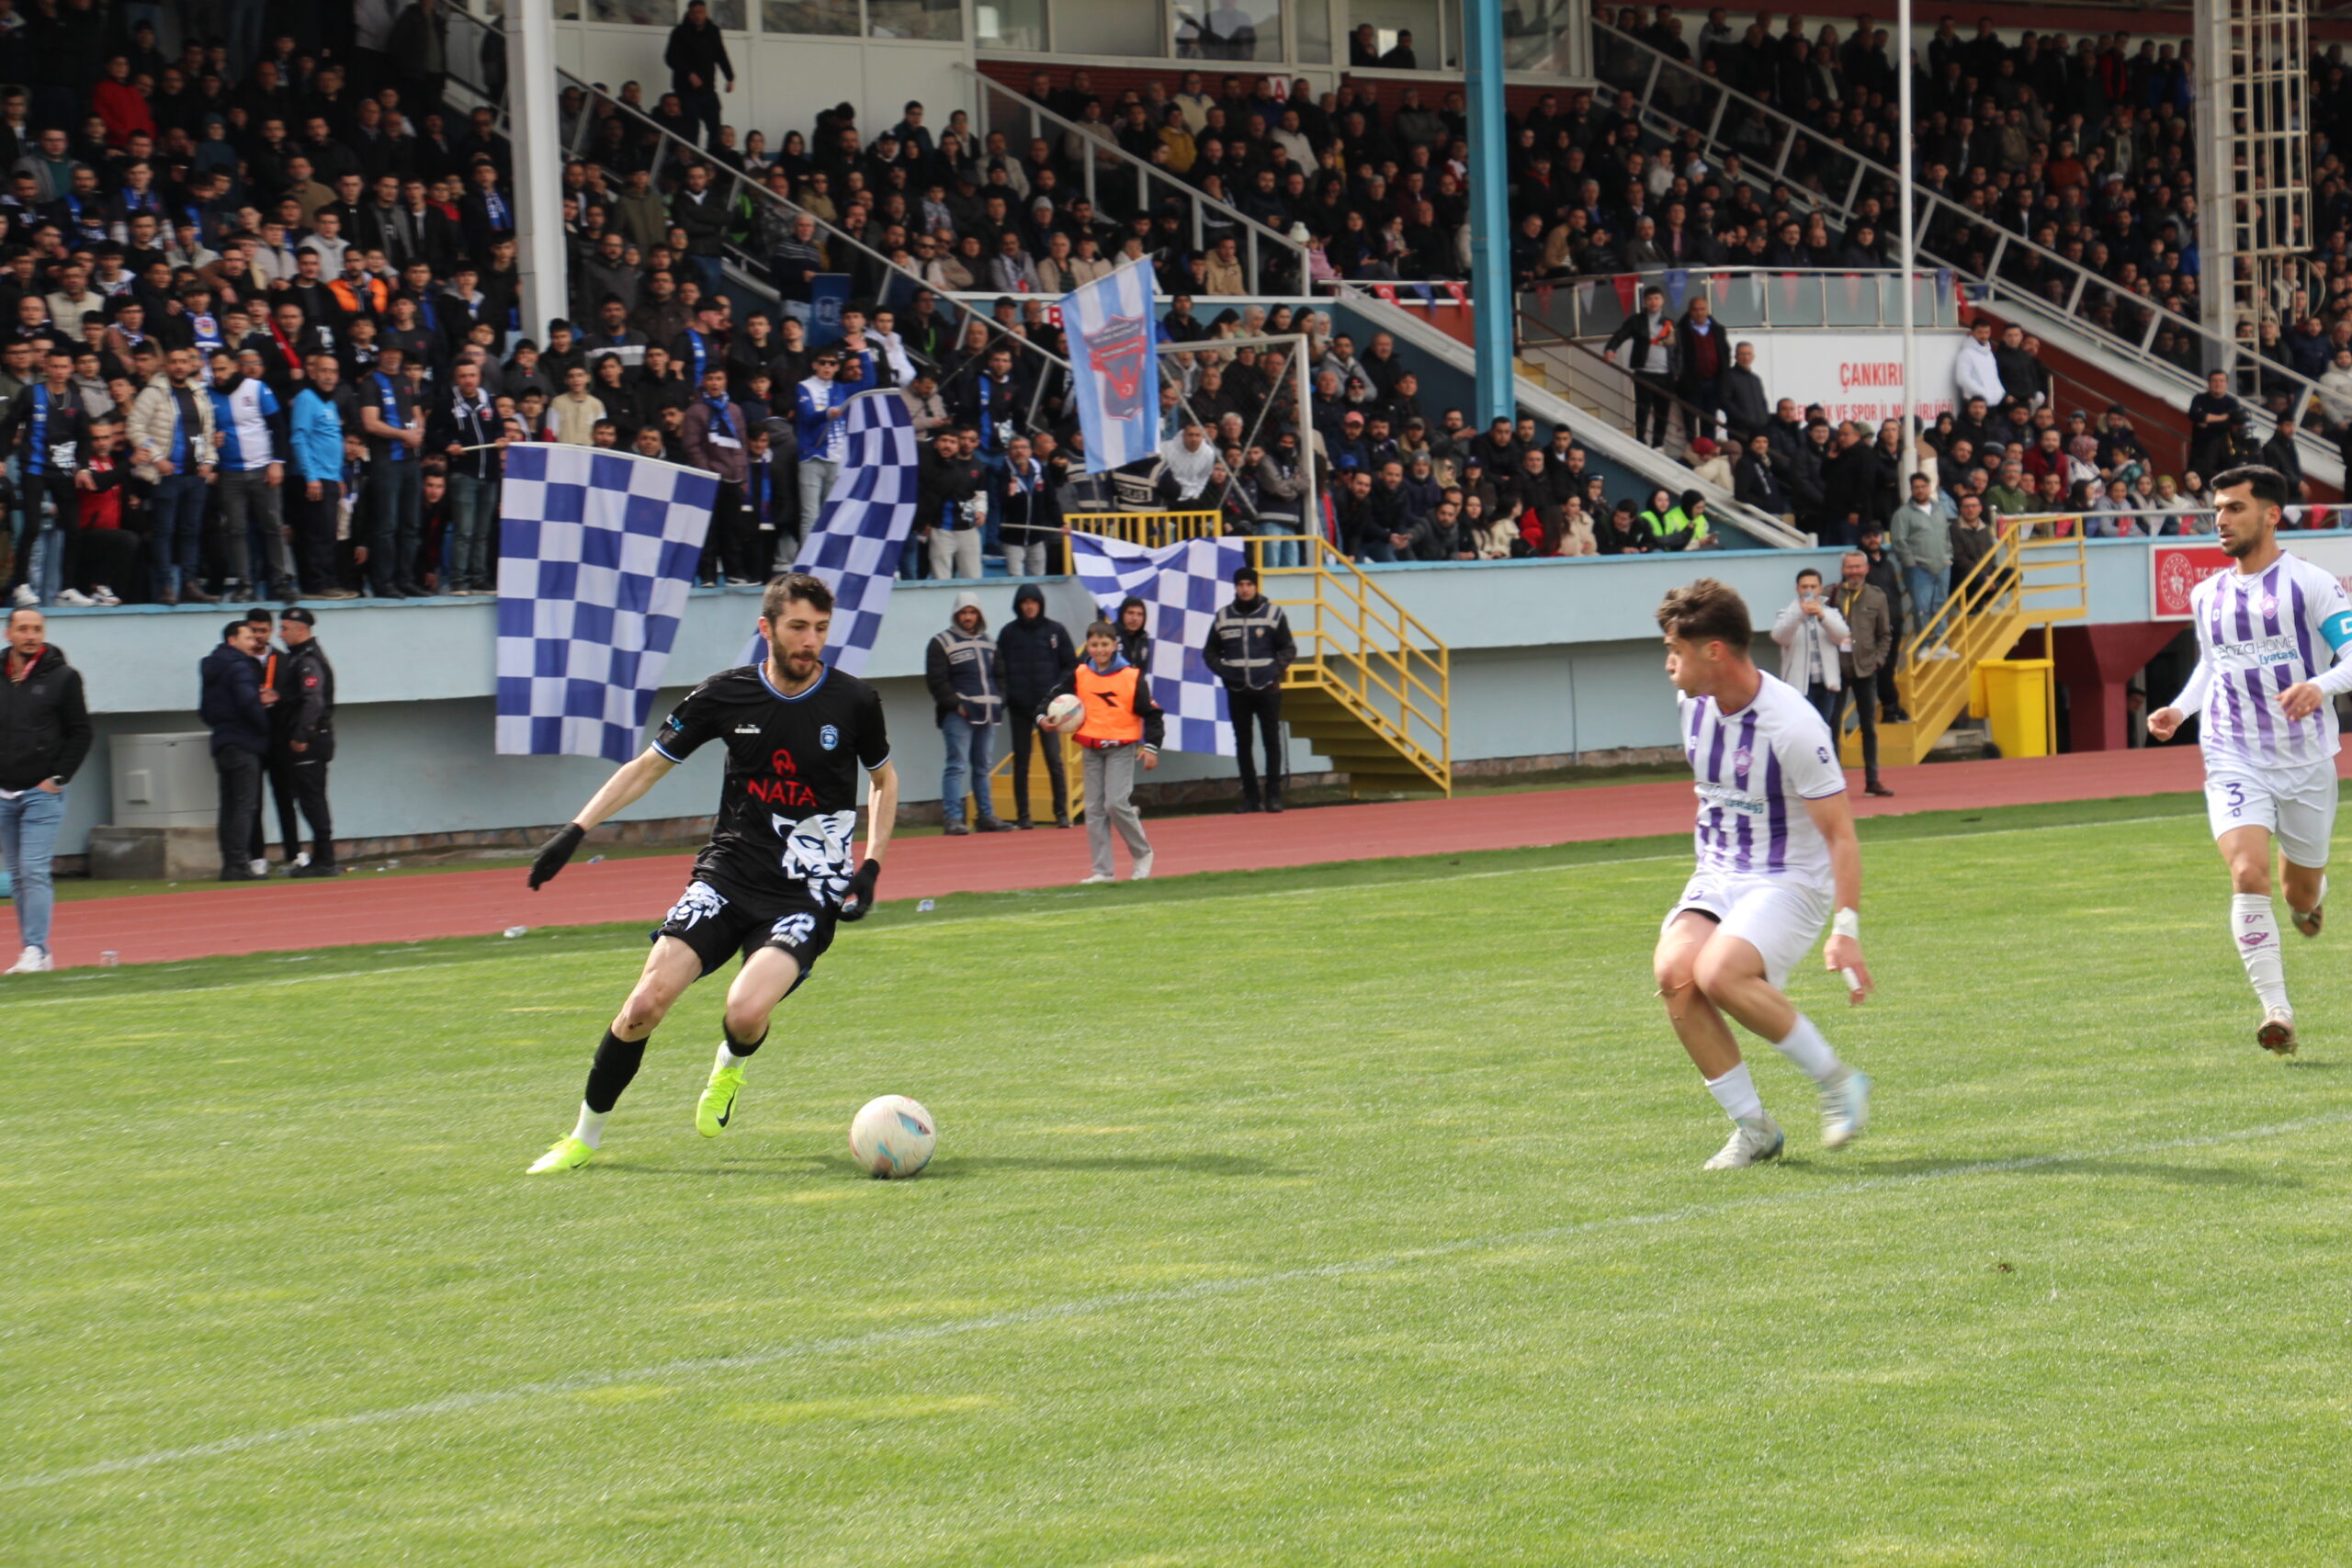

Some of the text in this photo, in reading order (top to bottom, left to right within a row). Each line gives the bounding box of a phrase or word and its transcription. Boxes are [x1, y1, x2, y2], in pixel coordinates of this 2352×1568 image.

[1840, 362, 1904, 394] ÇANKIRI
[1836, 403, 1848, 421] VE
[1851, 403, 1877, 422] SPOR
[2256, 635, 2295, 654] HOME
[747, 778, 819, 807] NATA
[2225, 782, 2245, 807] 3
